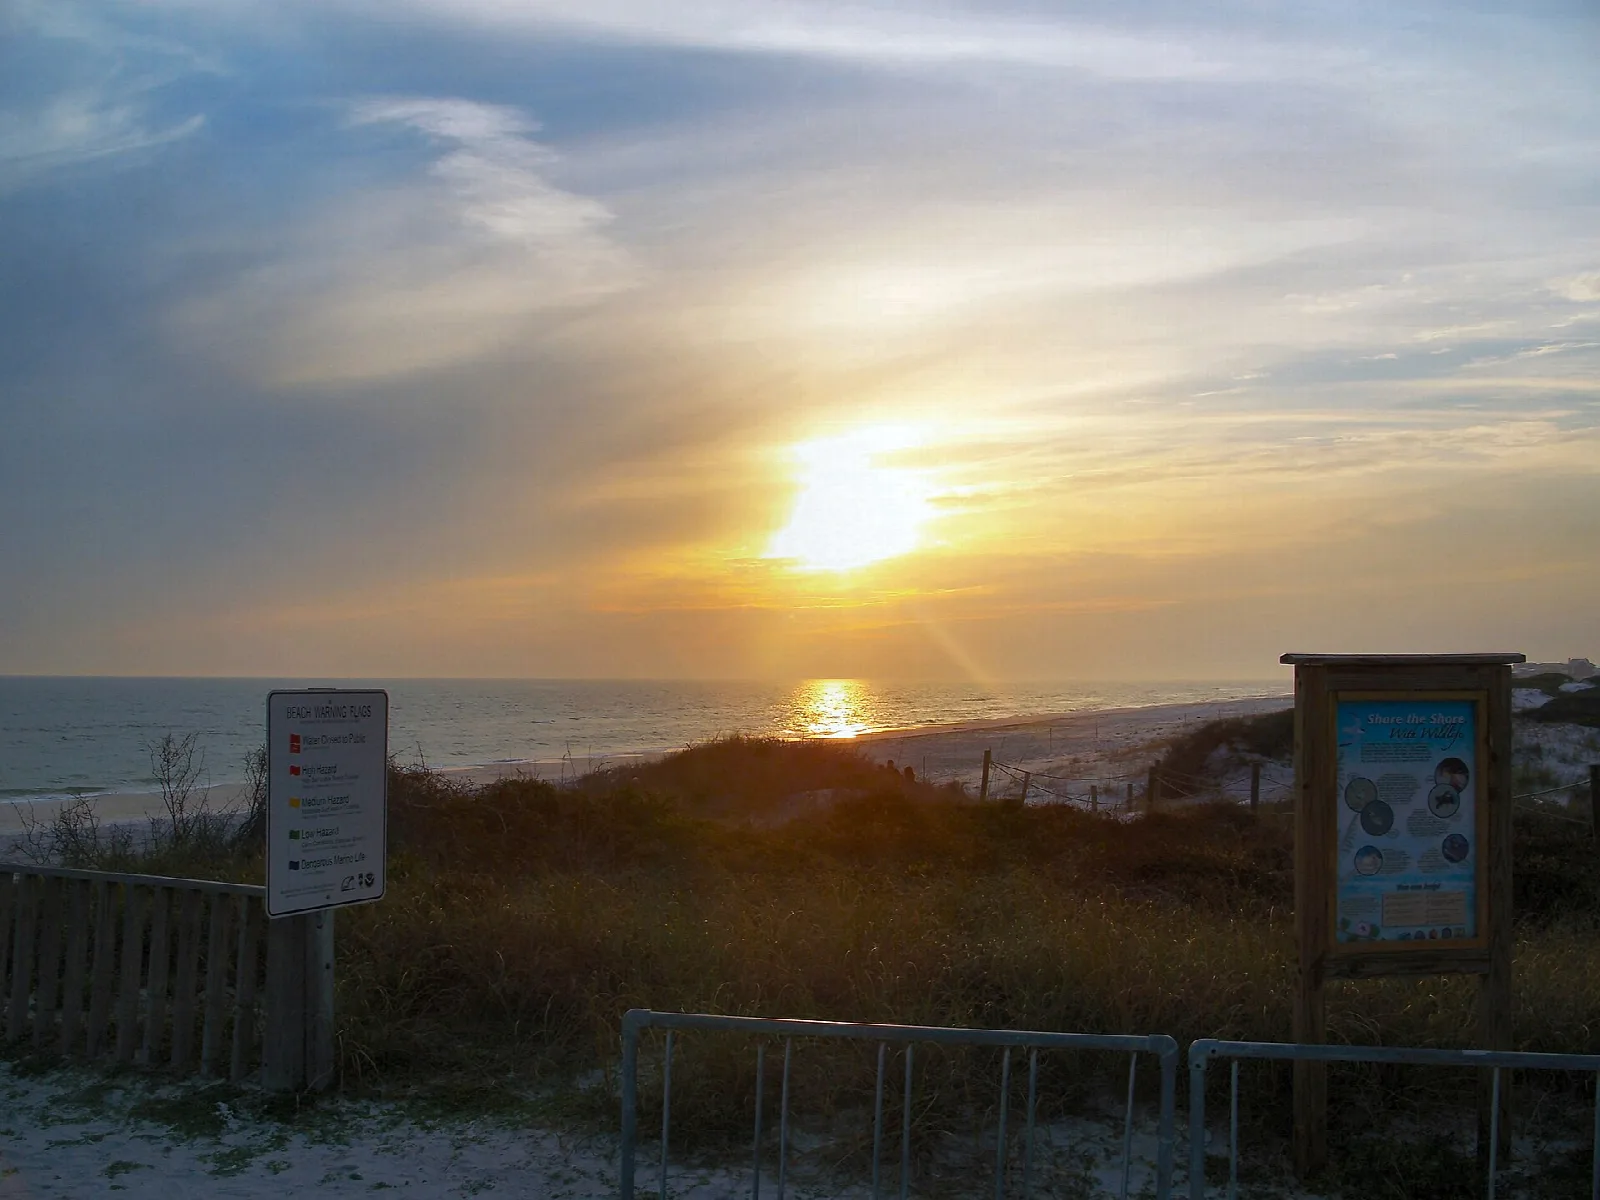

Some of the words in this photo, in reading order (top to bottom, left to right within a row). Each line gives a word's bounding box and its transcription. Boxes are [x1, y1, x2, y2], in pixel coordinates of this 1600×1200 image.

[287, 706, 311, 719] BEACH
[314, 705, 347, 718] WARNING
[350, 704, 371, 717] FLAGS
[1368, 713, 1403, 724] Share
[1407, 712, 1426, 724] the
[1430, 712, 1465, 724] Shore
[321, 734, 341, 744] Closed
[302, 765, 316, 777] High
[317, 763, 337, 774] Hazard
[302, 796, 326, 807] Medium
[327, 795, 350, 805] Hazard
[302, 829, 315, 840] Low
[316, 827, 339, 837] Hazard
[355, 852, 366, 862] Life
